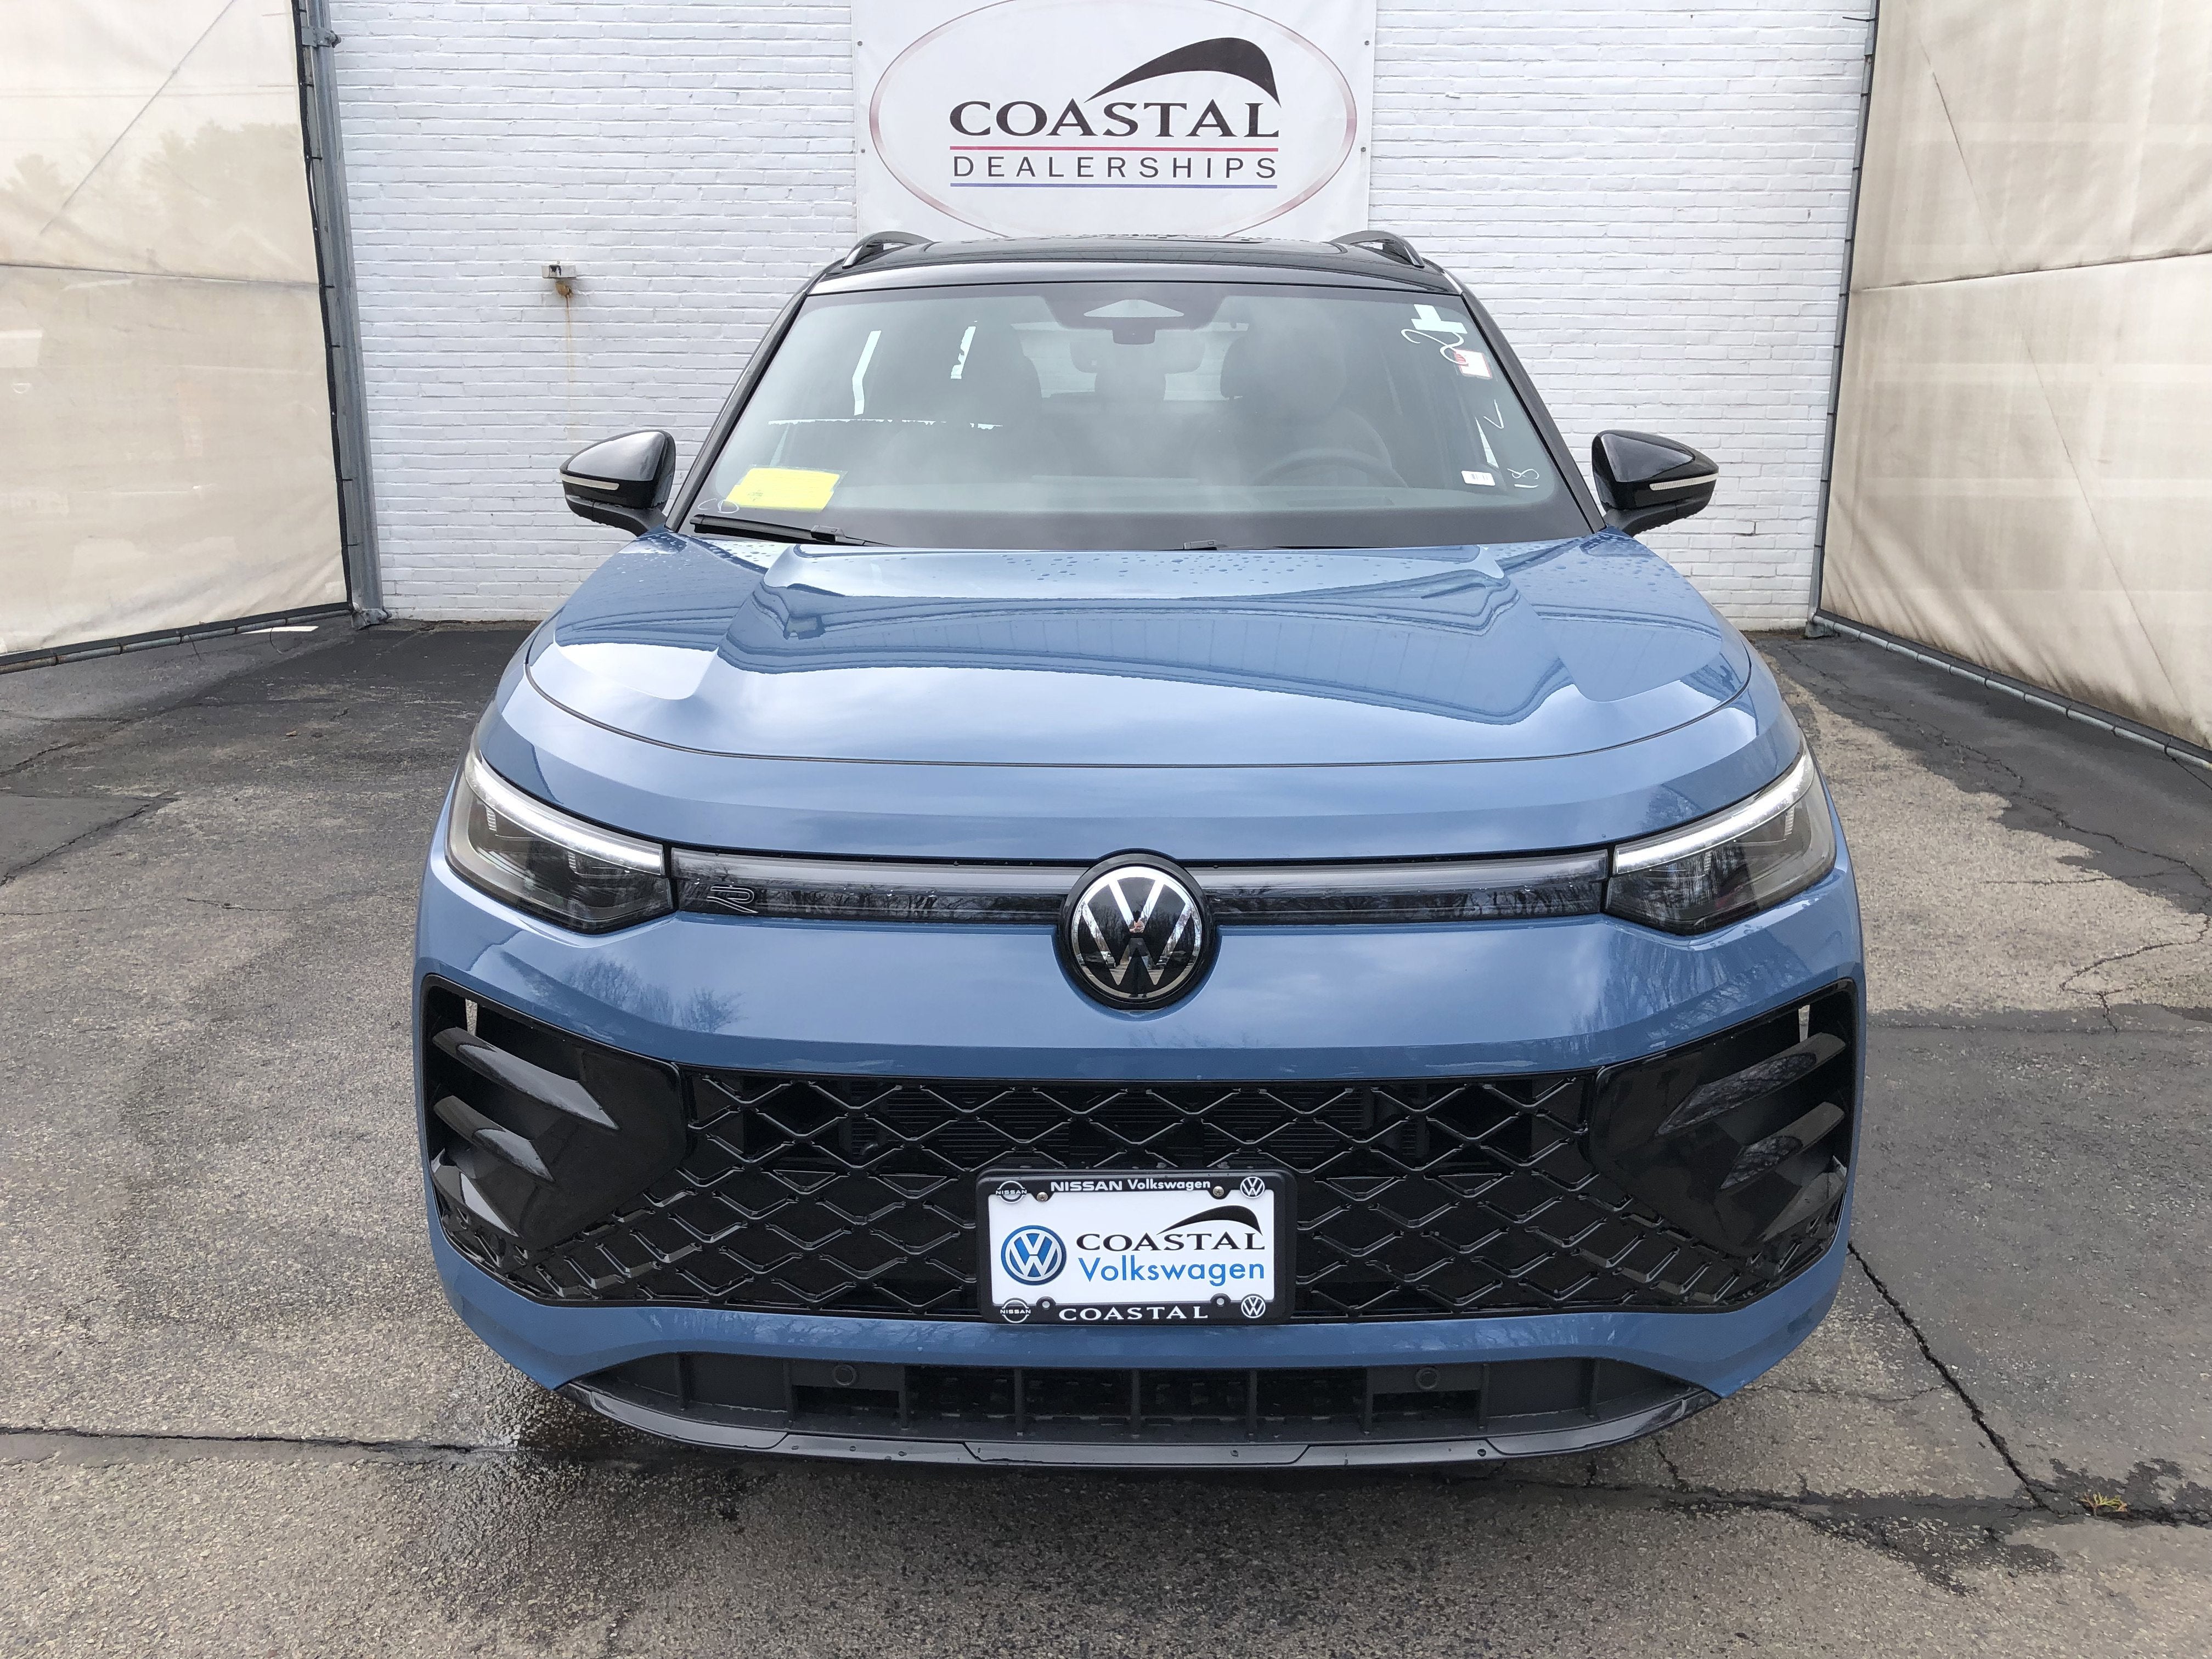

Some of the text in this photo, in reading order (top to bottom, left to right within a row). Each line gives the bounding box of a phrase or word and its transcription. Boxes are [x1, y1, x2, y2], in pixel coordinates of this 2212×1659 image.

[950, 98, 1279, 138] COASTAL
[953, 156, 1276, 179] DEALERSHIPS
[1051, 1178, 1211, 1192] NISSAN Volkswagen
[1076, 1232, 1265, 1251] COASTAL
[1078, 1255, 1265, 1286] Volkswagen
[1058, 1306, 1209, 1321] COASTAL
